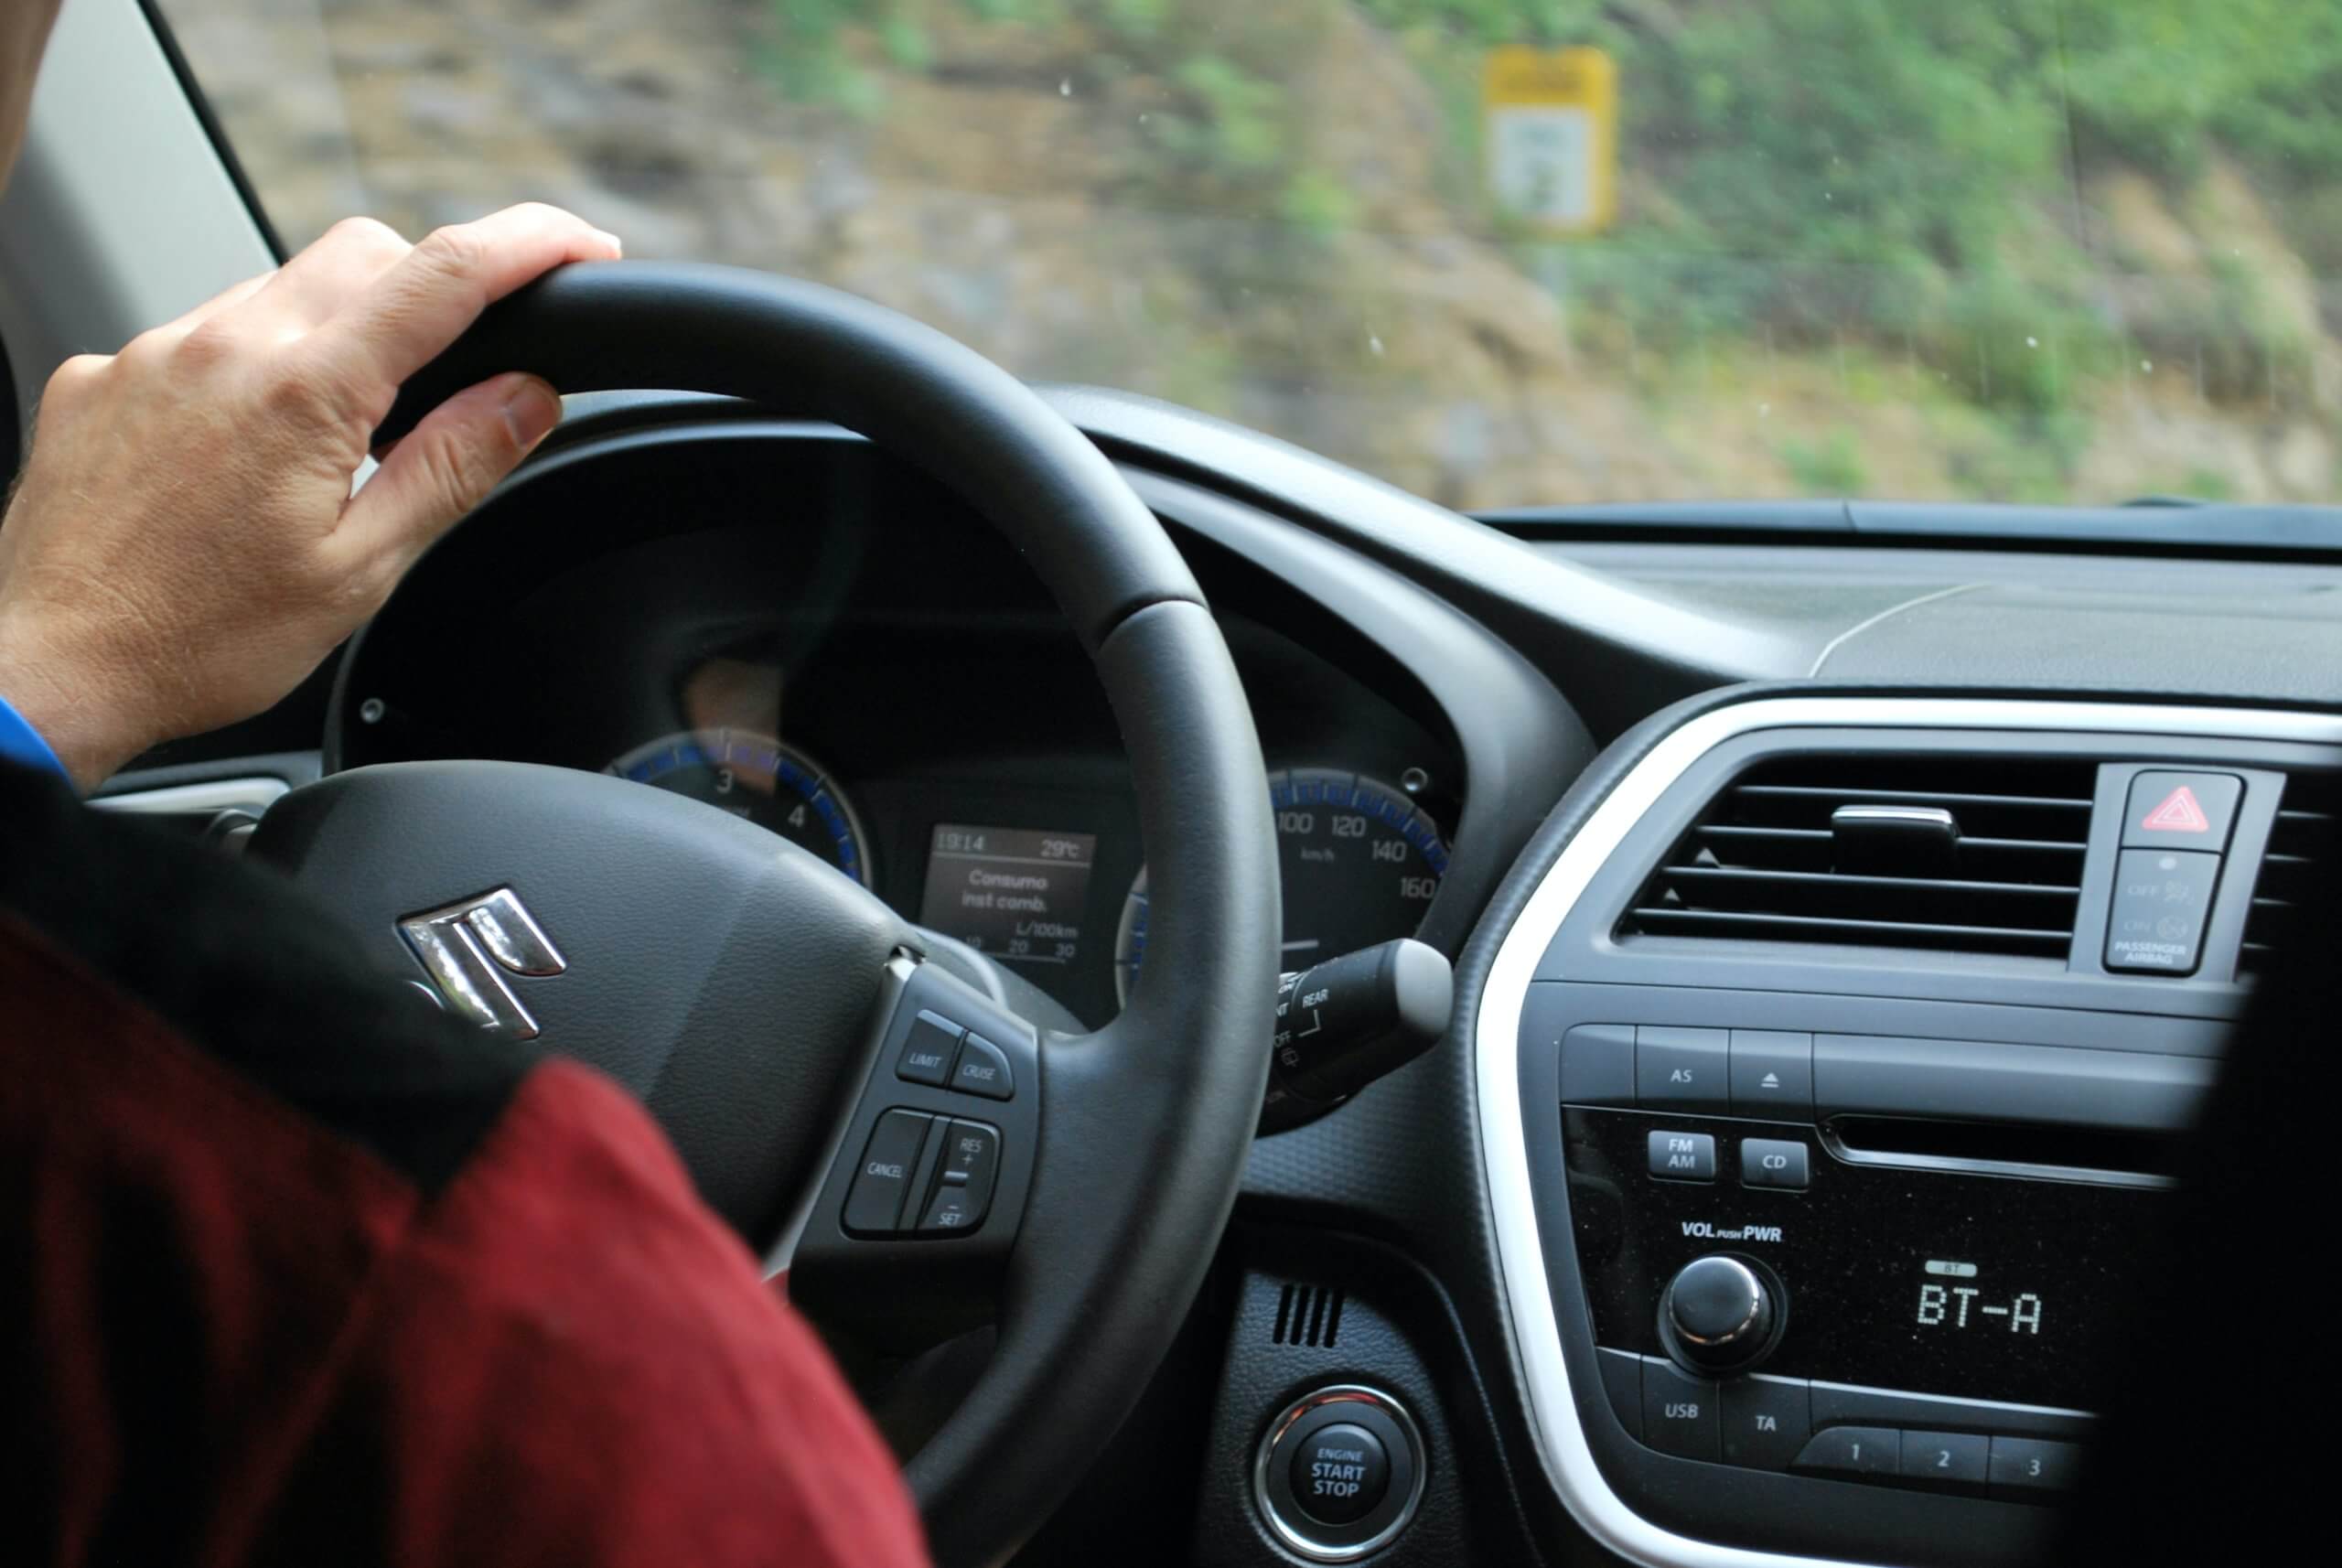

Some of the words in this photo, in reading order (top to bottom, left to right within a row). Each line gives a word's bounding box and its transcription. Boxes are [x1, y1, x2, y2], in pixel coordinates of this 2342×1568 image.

[715, 768, 733, 794] 3
[788, 804, 805, 827] 4
[1279, 812, 1314, 834] 100
[1331, 815, 1366, 838] 120
[1301, 846, 1335, 863] km/h
[1373, 840, 1407, 863] 140
[968, 869, 1048, 891] Consumo
[1401, 876, 1435, 899] 160
[962, 891, 994, 908] inst
[996, 894, 1047, 912] comb.
[1015, 920, 1079, 939] L/100km
[1009, 939, 1028, 954] 20
[1056, 943, 1076, 958] 30
[2114, 940, 2187, 956] PASSENGER
[2123, 951, 2174, 965] AIRBAG
[1302, 988, 1329, 1008] REAR
[908, 1053, 942, 1069] LIMIT
[962, 1064, 996, 1080] CRUISE
[1670, 1069, 1693, 1083] AS
[960, 1138, 983, 1154] RES
[1669, 1138, 1693, 1153] FM
[867, 1161, 903, 1178] CANCEL
[1668, 1155, 1695, 1169] AM
[1762, 1155, 1787, 1169] CD
[939, 1212, 962, 1226] SET
[1681, 1221, 1715, 1238] VOL
[1716, 1229, 1743, 1240] PUSH
[1743, 1225, 1783, 1242] PWR
[1918, 1283, 2042, 1335] BT-A
[1664, 1403, 1699, 1420] USB
[1755, 1415, 1777, 1432] TA
[1316, 1447, 1364, 1463] ENGINE
[1851, 1444, 1860, 1461] 1
[1938, 1451, 1950, 1467] 2
[1311, 1463, 1366, 1482] START
[2028, 1459, 2041, 1477] 3
[1313, 1480, 1359, 1498] STOP
